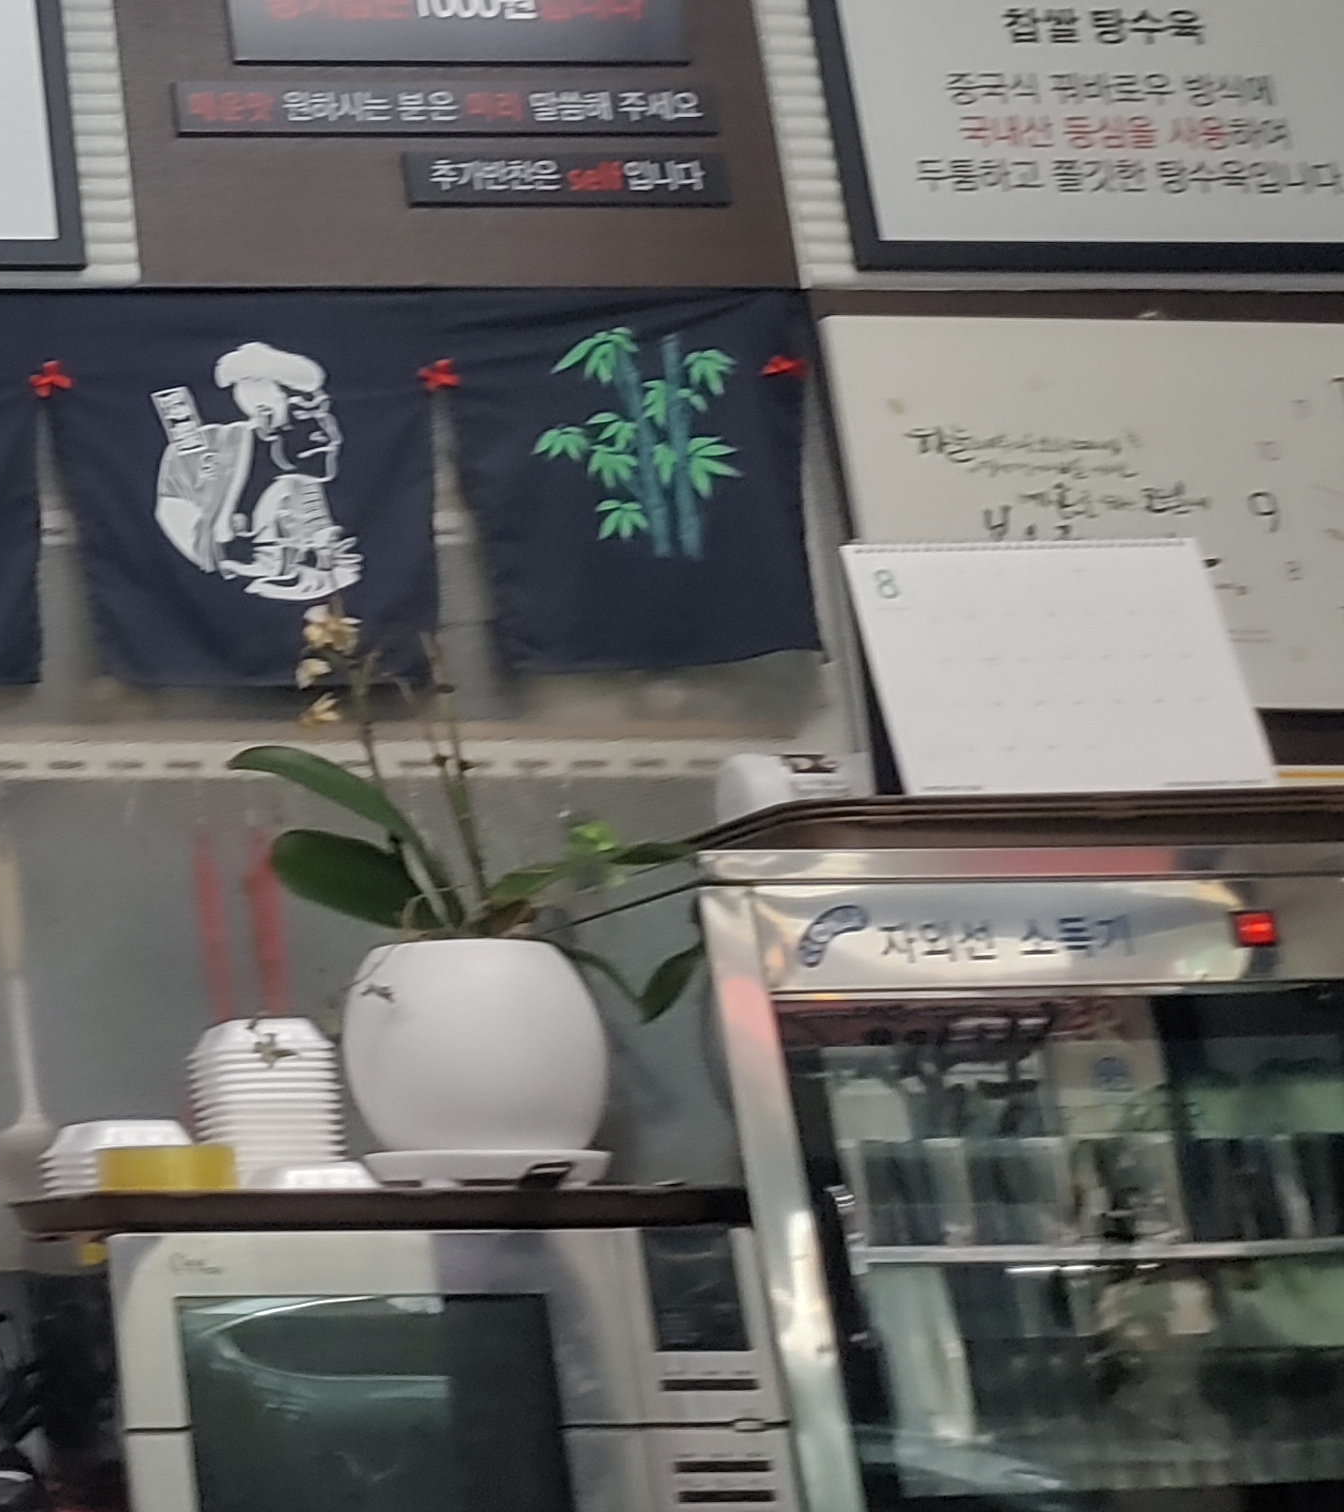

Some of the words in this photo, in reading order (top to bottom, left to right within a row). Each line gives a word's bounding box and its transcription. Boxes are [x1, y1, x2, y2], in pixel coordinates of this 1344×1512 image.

[1003, 8, 1081, 45] 찹쌀
[1091, 8, 1206, 45] 탕수육
[396, 90, 459, 122] 분은
[616, 90, 705, 122] 주세요
[958, 116, 1055, 149] 국내산
[1062, 116, 1160, 150] 등심을
[1168, 116, 1292, 151] 사용하여
[428, 159, 561, 191] 추가반찬은
[917, 159, 1046, 193] 두툼하고
[1051, 159, 1148, 193] 쫄깃한
[874, 568, 900, 600] 8
[878, 921, 997, 963] 자외선
